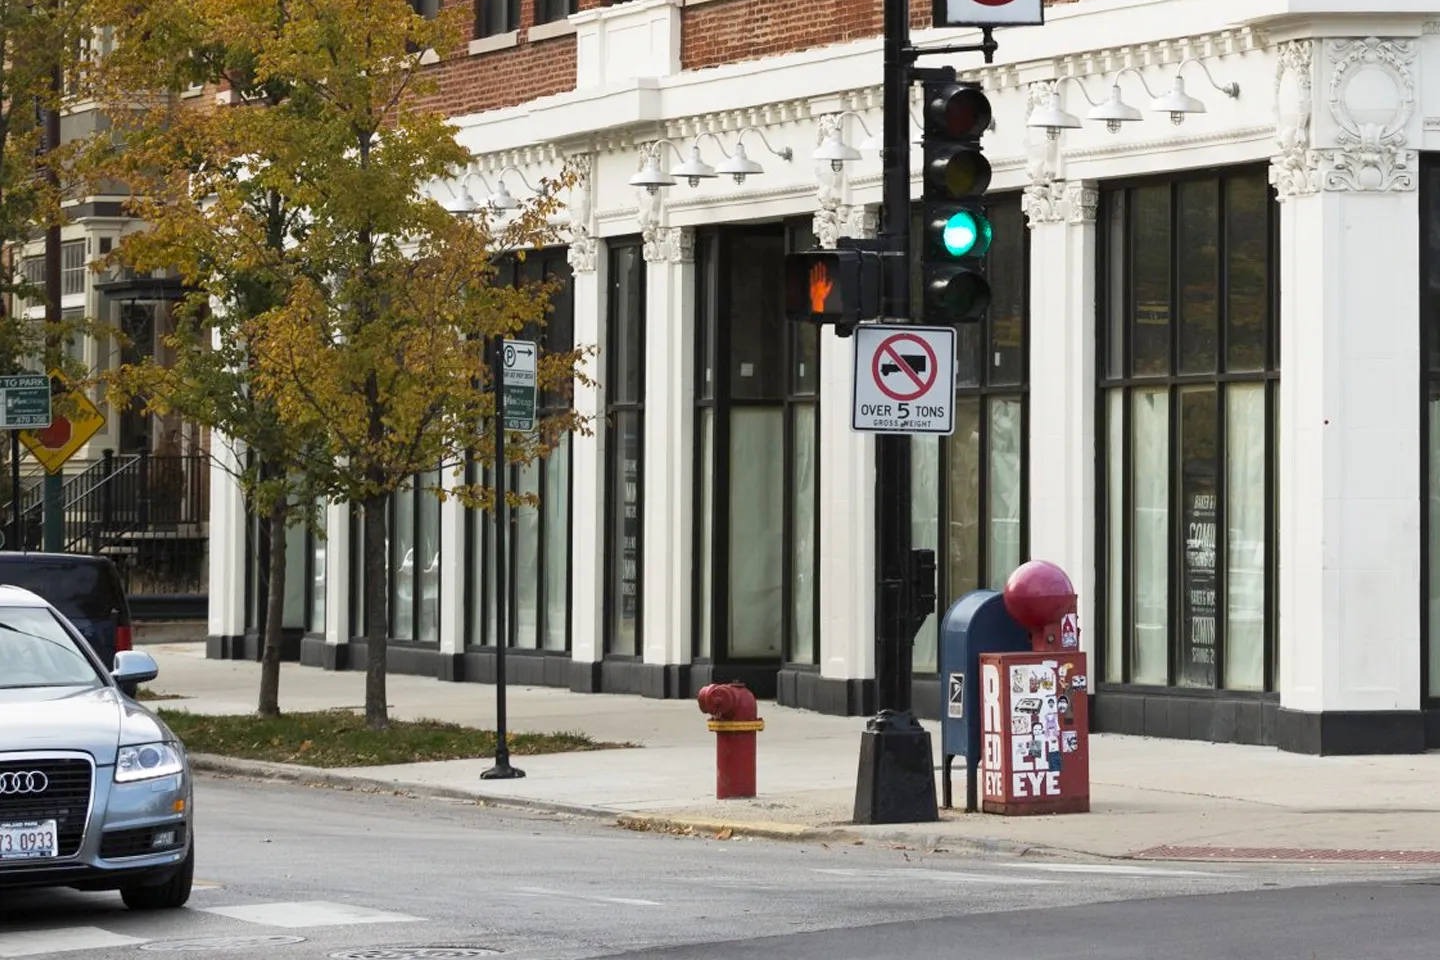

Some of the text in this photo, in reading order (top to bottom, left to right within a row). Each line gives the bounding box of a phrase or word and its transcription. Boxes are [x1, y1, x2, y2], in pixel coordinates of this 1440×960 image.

[19, 378, 45, 386] PARK
[861, 403, 945, 419] OVER 5 TONS
[873, 419, 932, 428] GROSS WEIGHT
[983, 664, 1001, 732] R
[985, 734, 1001, 770] ED
[986, 771, 1002, 797] EYE
[1012, 771, 1061, 797] EYE
[21, 831, 53, 851] 0933
